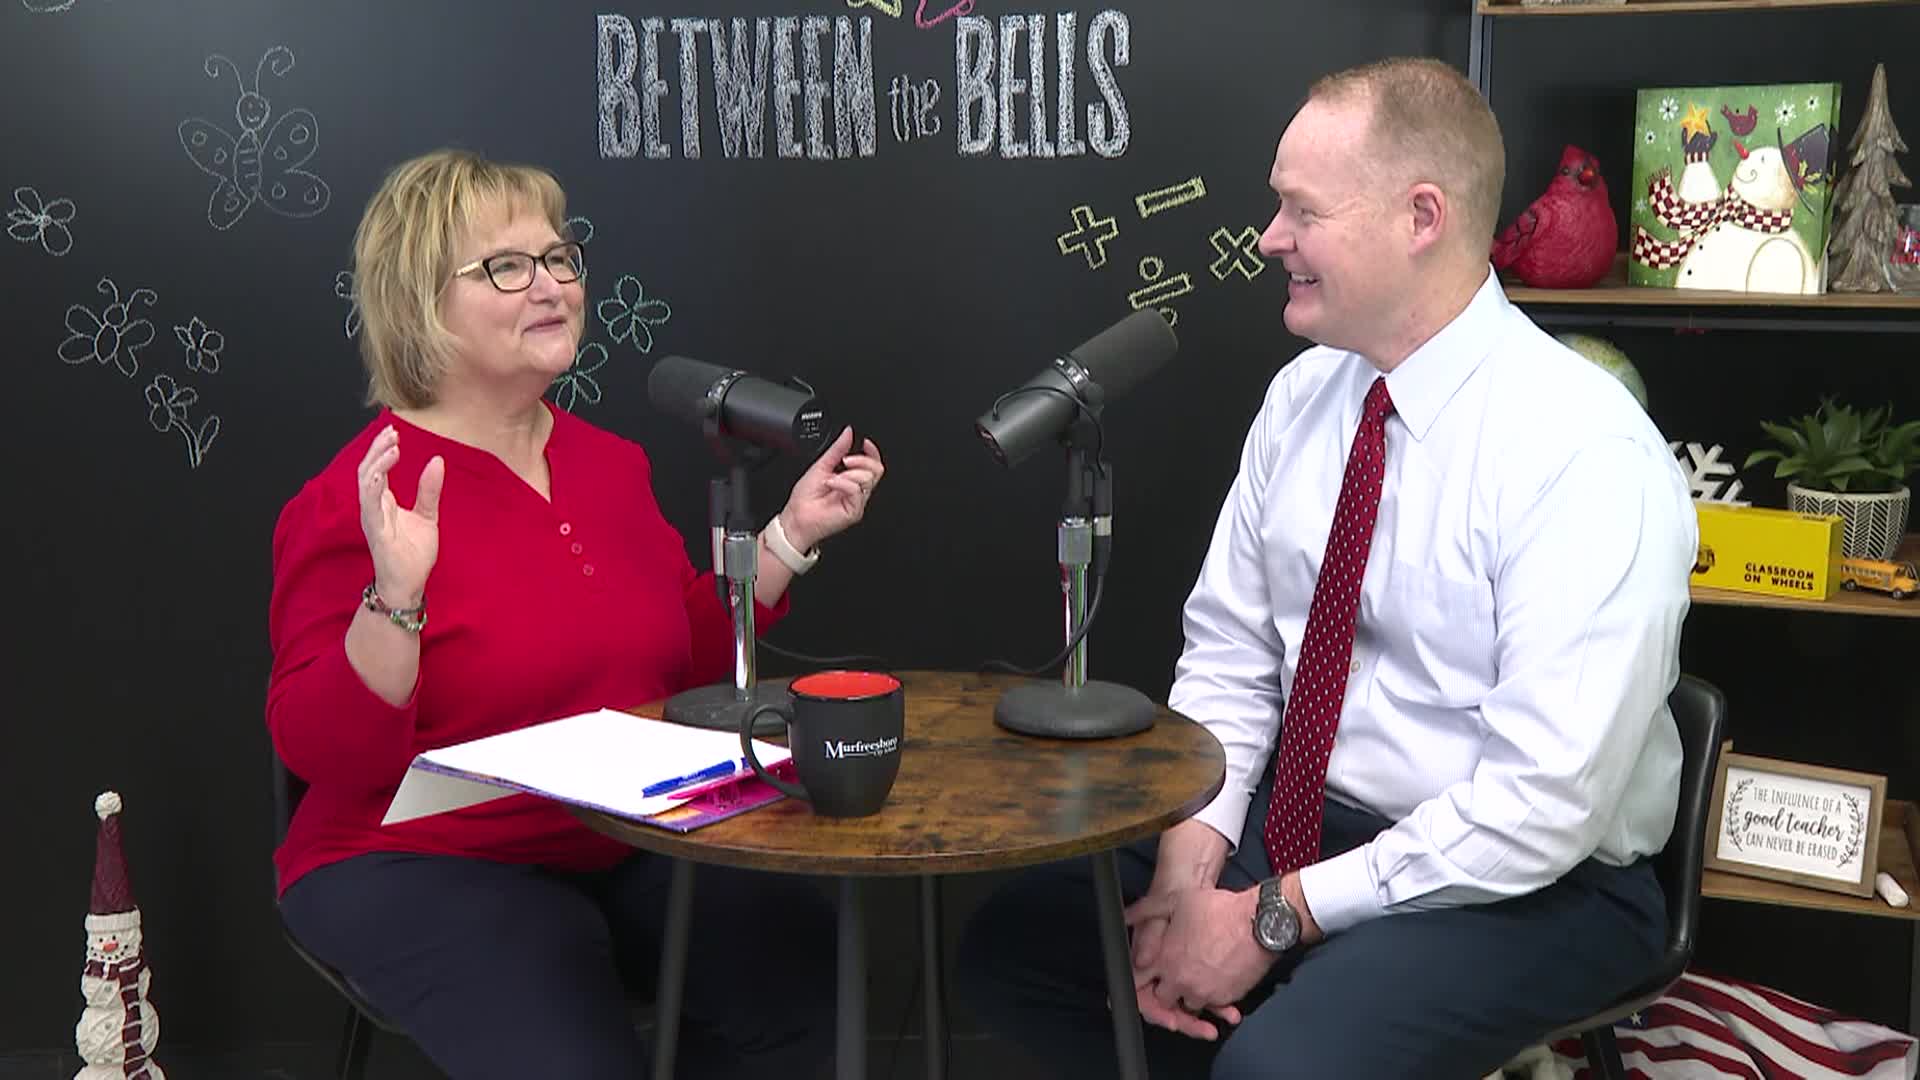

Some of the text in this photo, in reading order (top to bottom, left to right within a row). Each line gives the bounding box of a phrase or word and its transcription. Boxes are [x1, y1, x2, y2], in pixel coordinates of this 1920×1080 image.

[597, 10, 1130, 160] BETWEEN the BELLS
[1744, 573, 1814, 591] ON WHEELS
[1745, 562, 1814, 580] CLASSROOM
[1753, 787, 1842, 813] THE INFLUENCE OF A
[1742, 807, 1845, 842] good teacher
[1745, 832, 1838, 860] CAN NEVER BE ERASED
